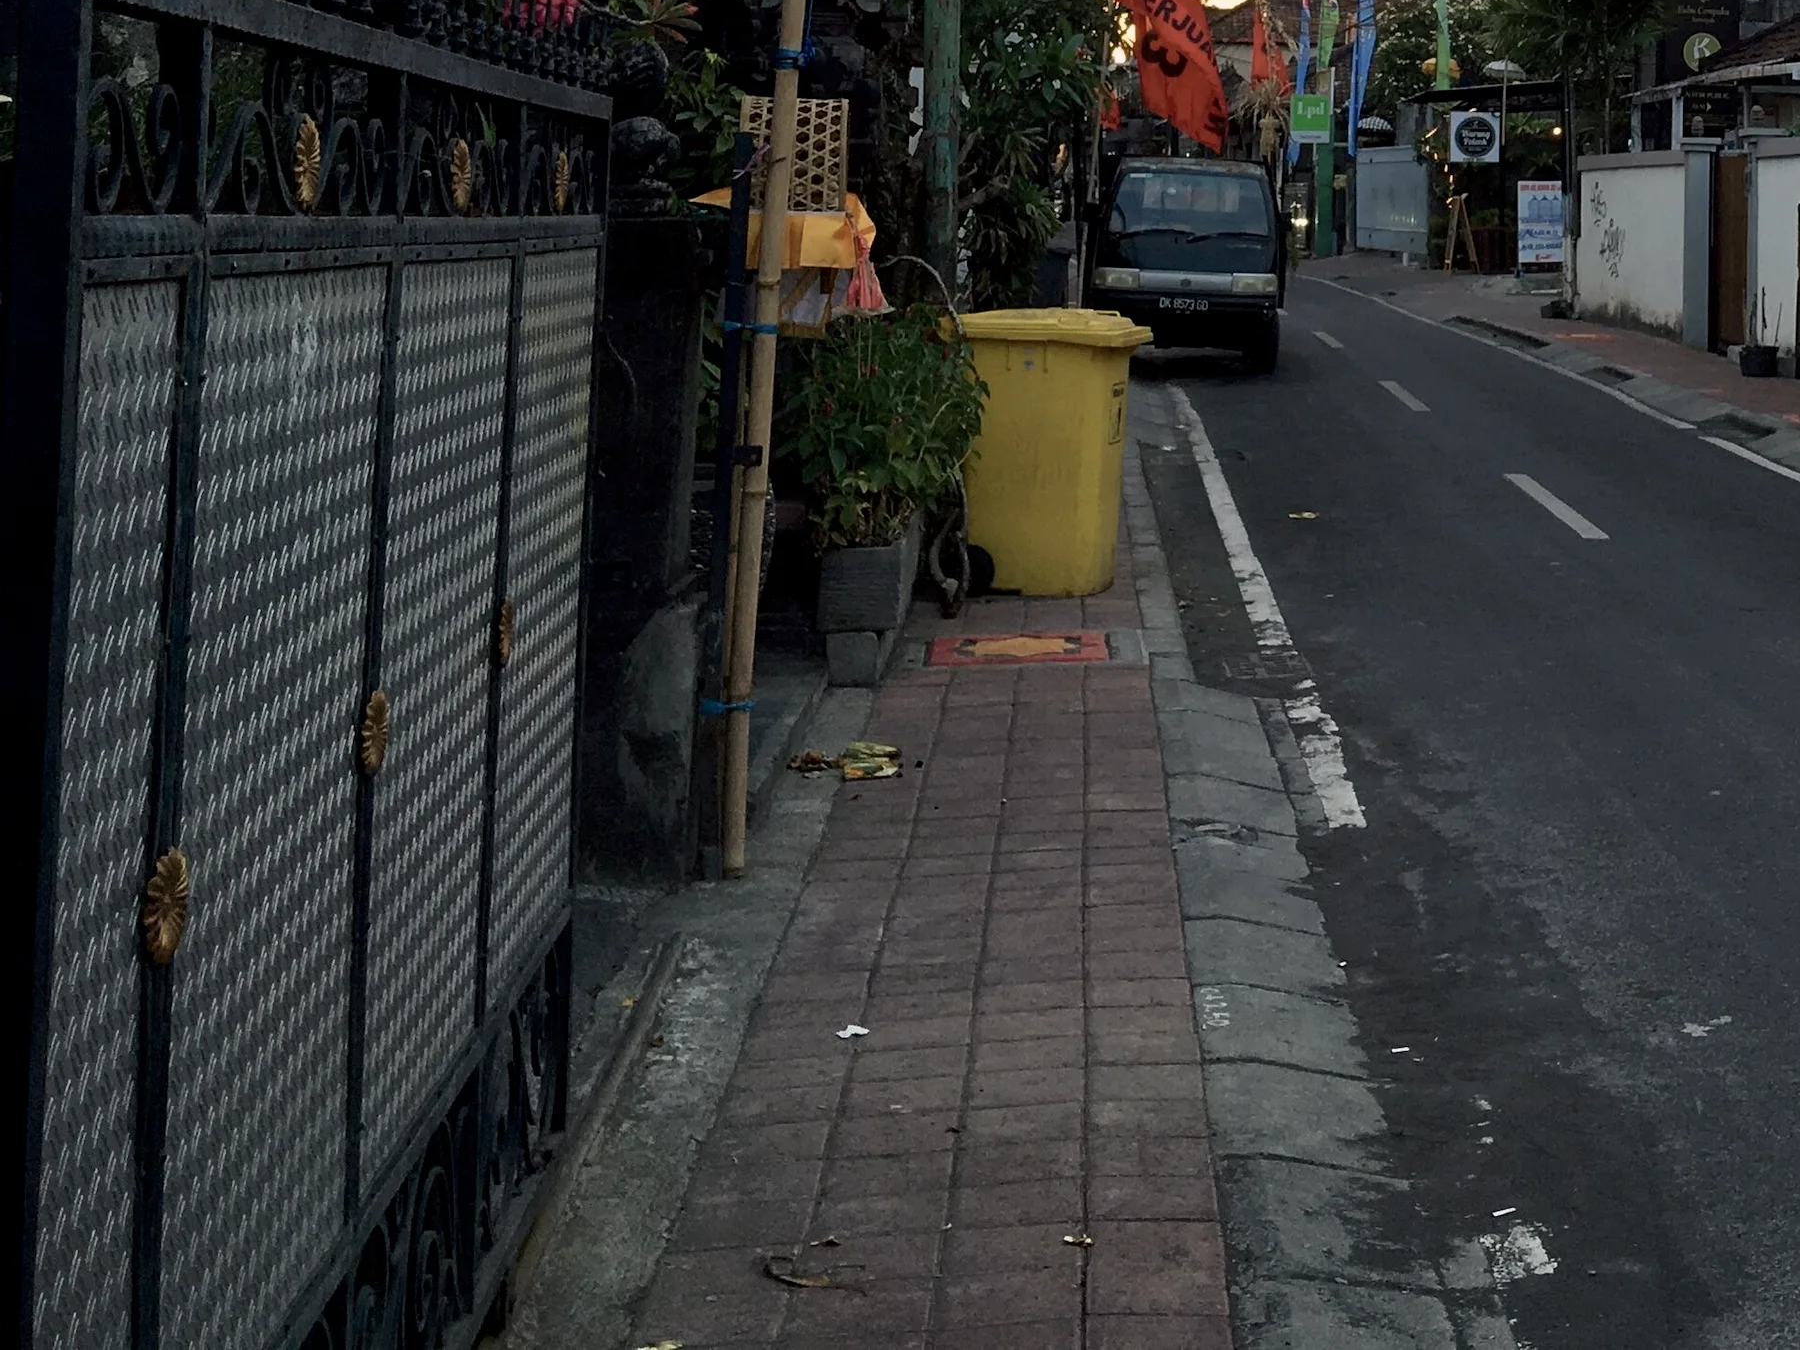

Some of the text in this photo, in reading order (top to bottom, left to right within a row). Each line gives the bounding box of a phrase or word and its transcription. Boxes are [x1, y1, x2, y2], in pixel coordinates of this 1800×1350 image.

[1297, 101, 1325, 119] Lpd
[1159, 296, 1171, 309] DK
[1173, 298, 1195, 311] 8573
